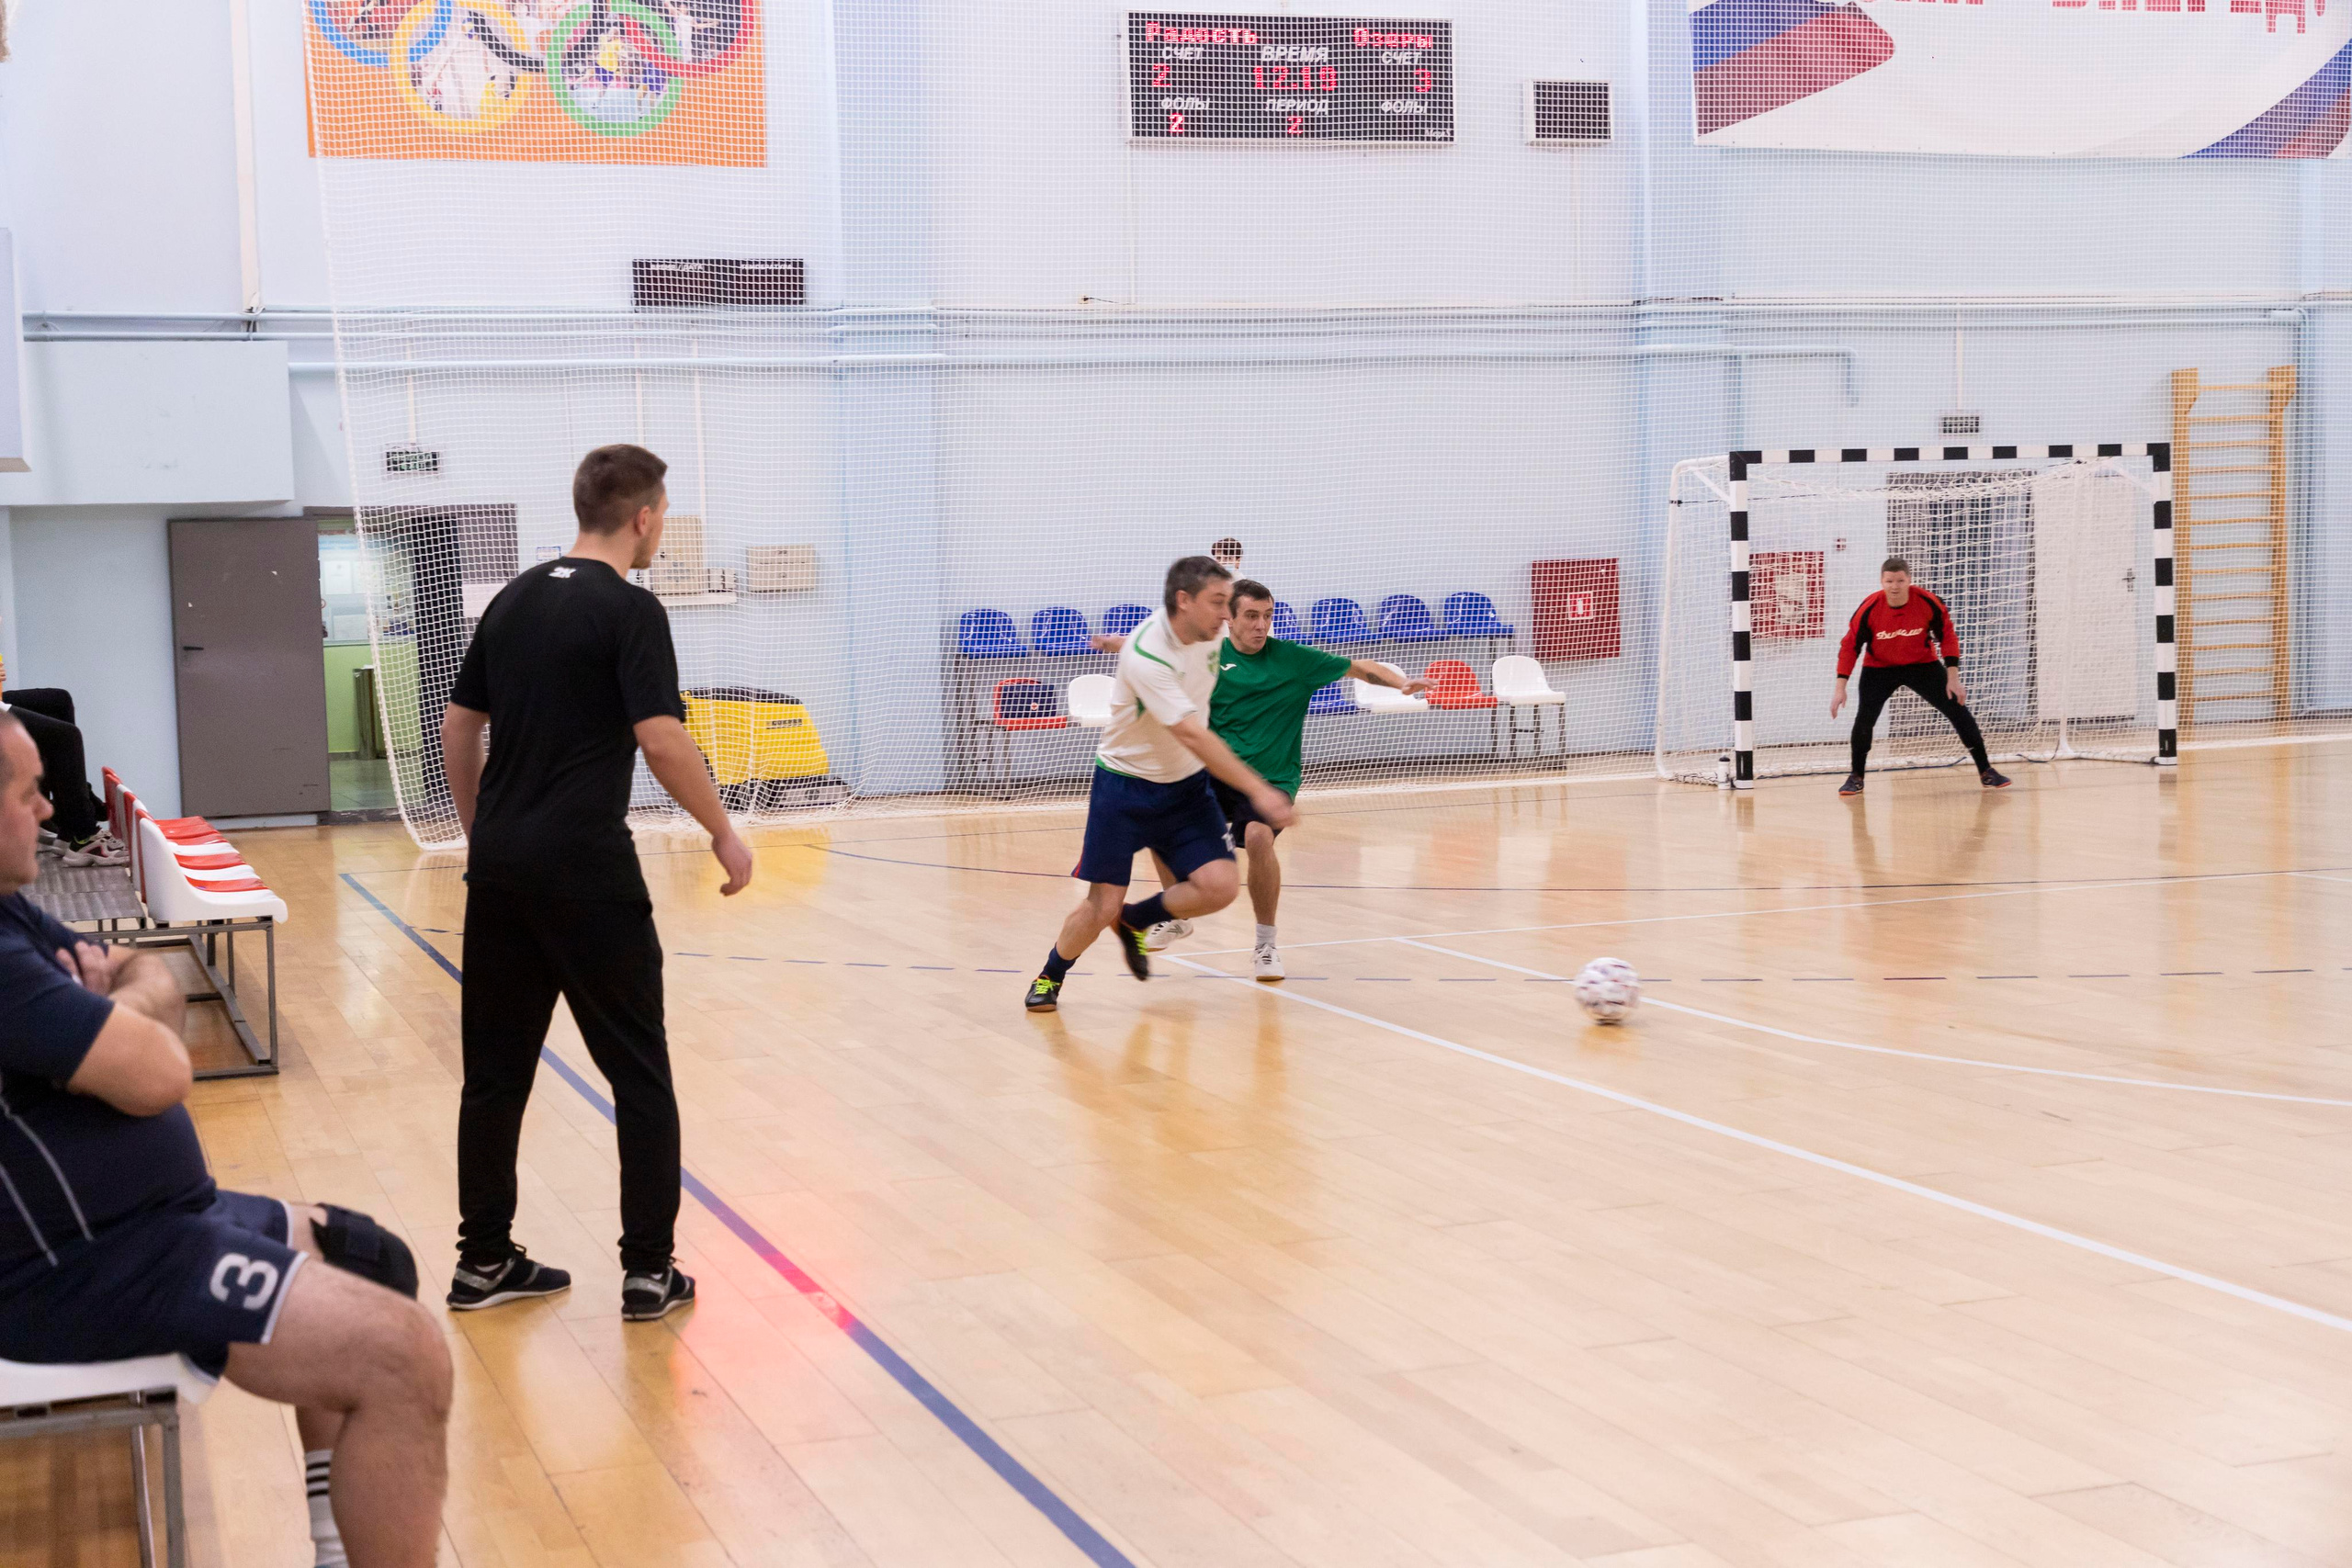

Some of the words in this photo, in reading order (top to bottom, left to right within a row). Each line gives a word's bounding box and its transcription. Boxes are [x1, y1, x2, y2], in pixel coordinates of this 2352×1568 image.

[1161, 47, 1204, 61] СЧЕТ
[1261, 46, 1329, 62] ВРЕМЯ
[1381, 51, 1422, 65] СЧЕТ
[1152, 63, 1171, 88] 2
[1160, 97, 1211, 110] ФОЛЫ
[1265, 98, 1329, 116] ПЕРИОД
[1381, 101, 1429, 114] ФОЛЫ
[1169, 112, 1185, 133] 2
[1287, 116, 1304, 134] 2
[209, 1253, 279, 1312] 3
